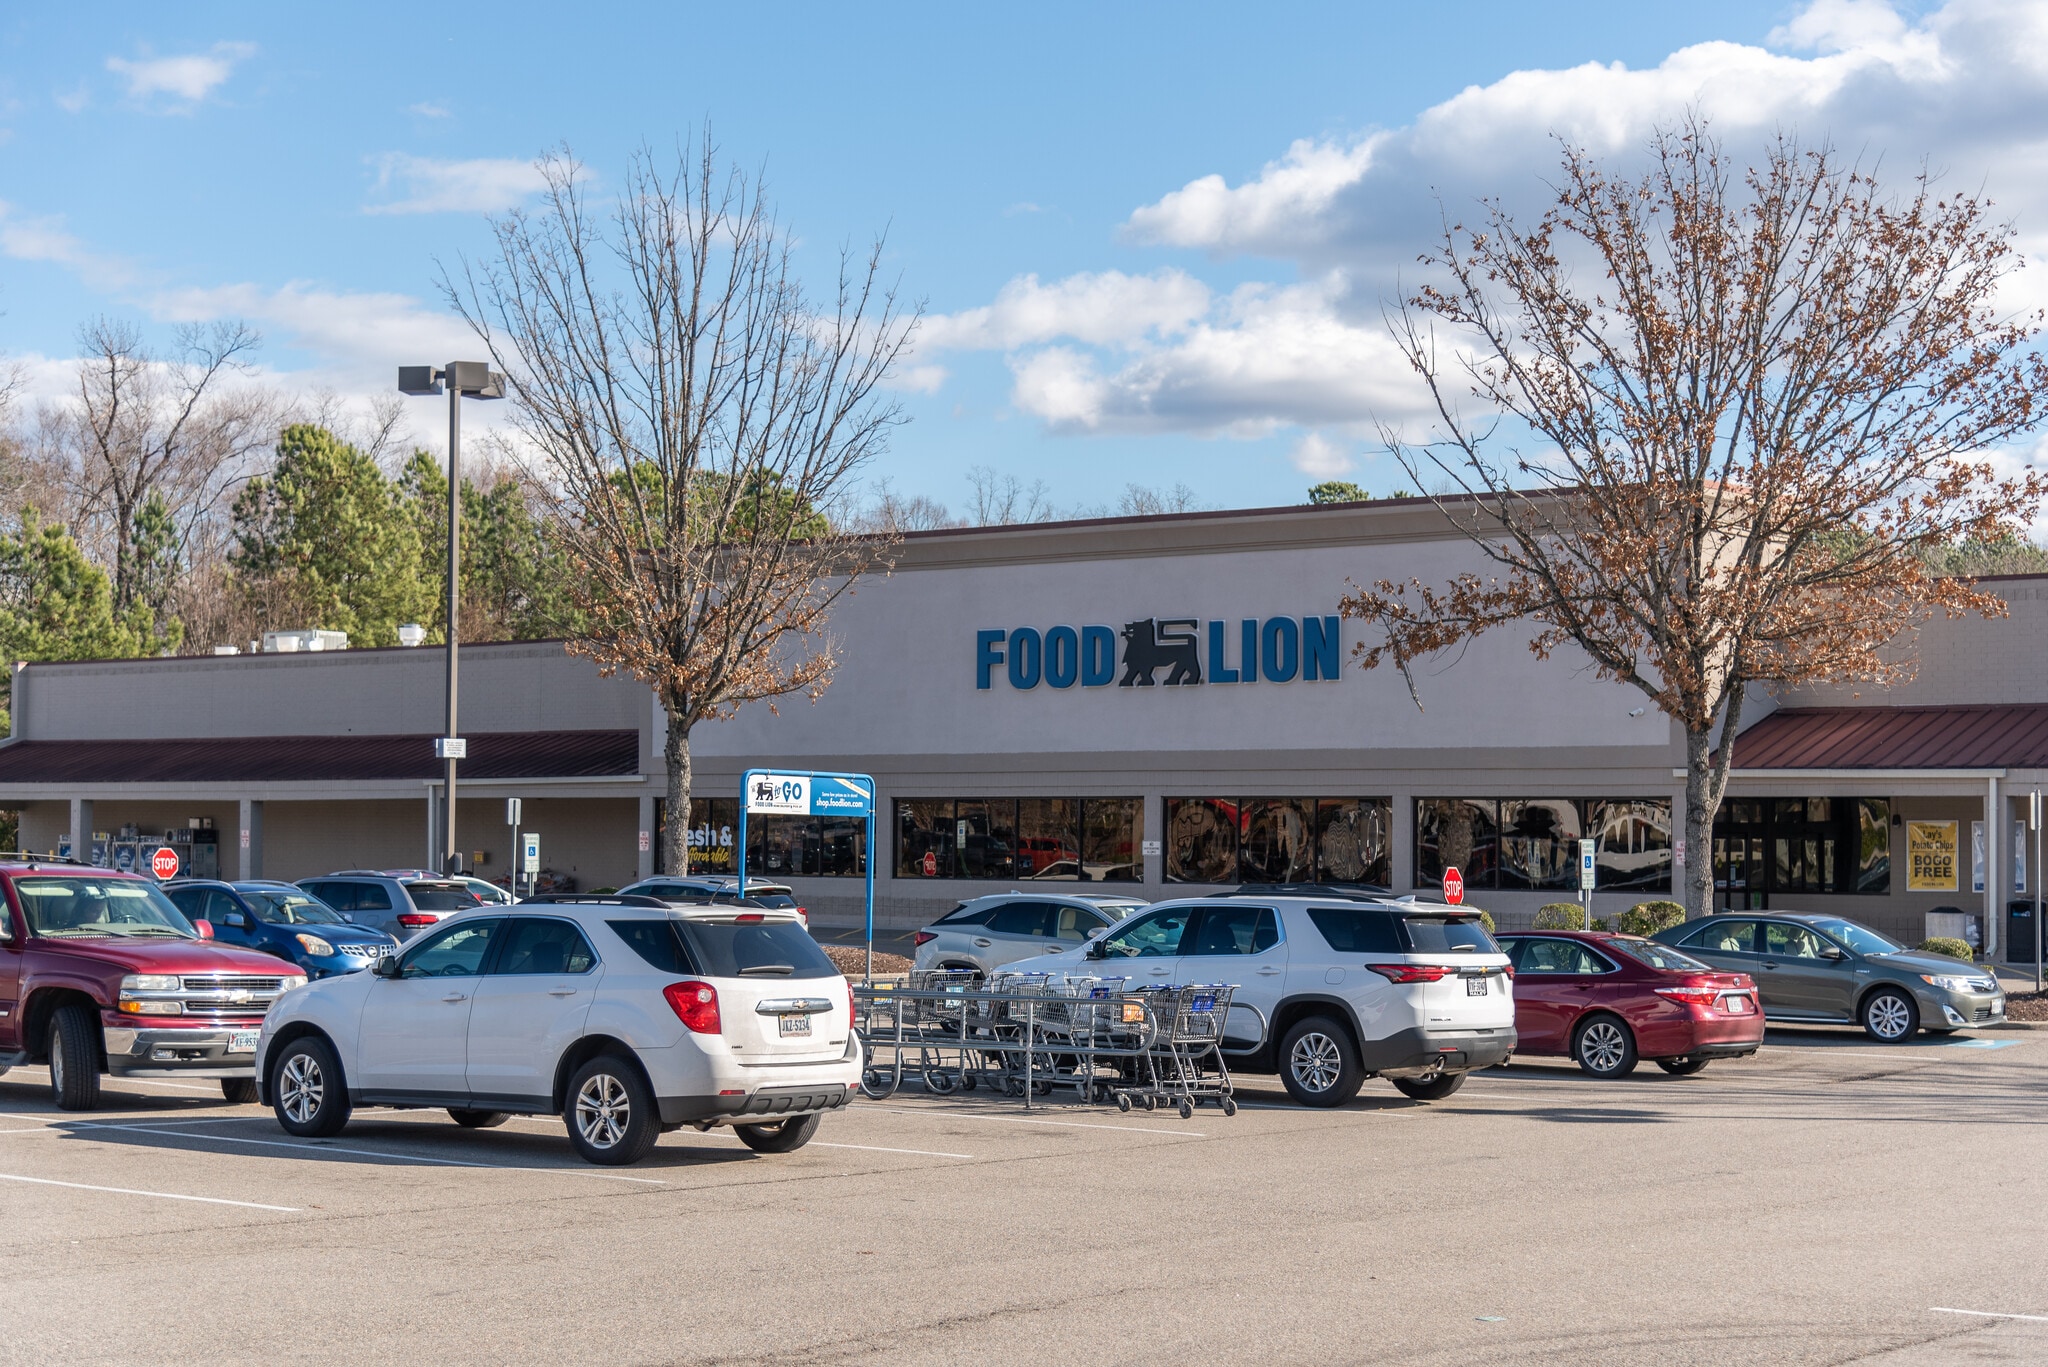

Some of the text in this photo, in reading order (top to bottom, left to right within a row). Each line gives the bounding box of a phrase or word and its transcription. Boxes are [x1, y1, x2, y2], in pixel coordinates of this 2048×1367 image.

[976, 614, 1342, 690] FOOD LION
[782, 781, 803, 803] GO
[816, 797, 864, 808] shop.foodlion.com
[687, 823, 733, 847] esh &
[1922, 829, 1942, 840] Lay's
[1912, 840, 1953, 852] Potato Chips
[687, 846, 729, 865] ffordable
[1914, 855, 1952, 866] BOGO
[154, 858, 177, 870] STOP
[1914, 866, 1952, 878] FREE
[1446, 880, 1462, 897] STOP
[782, 1019, 810, 1032] JKZ-5234
